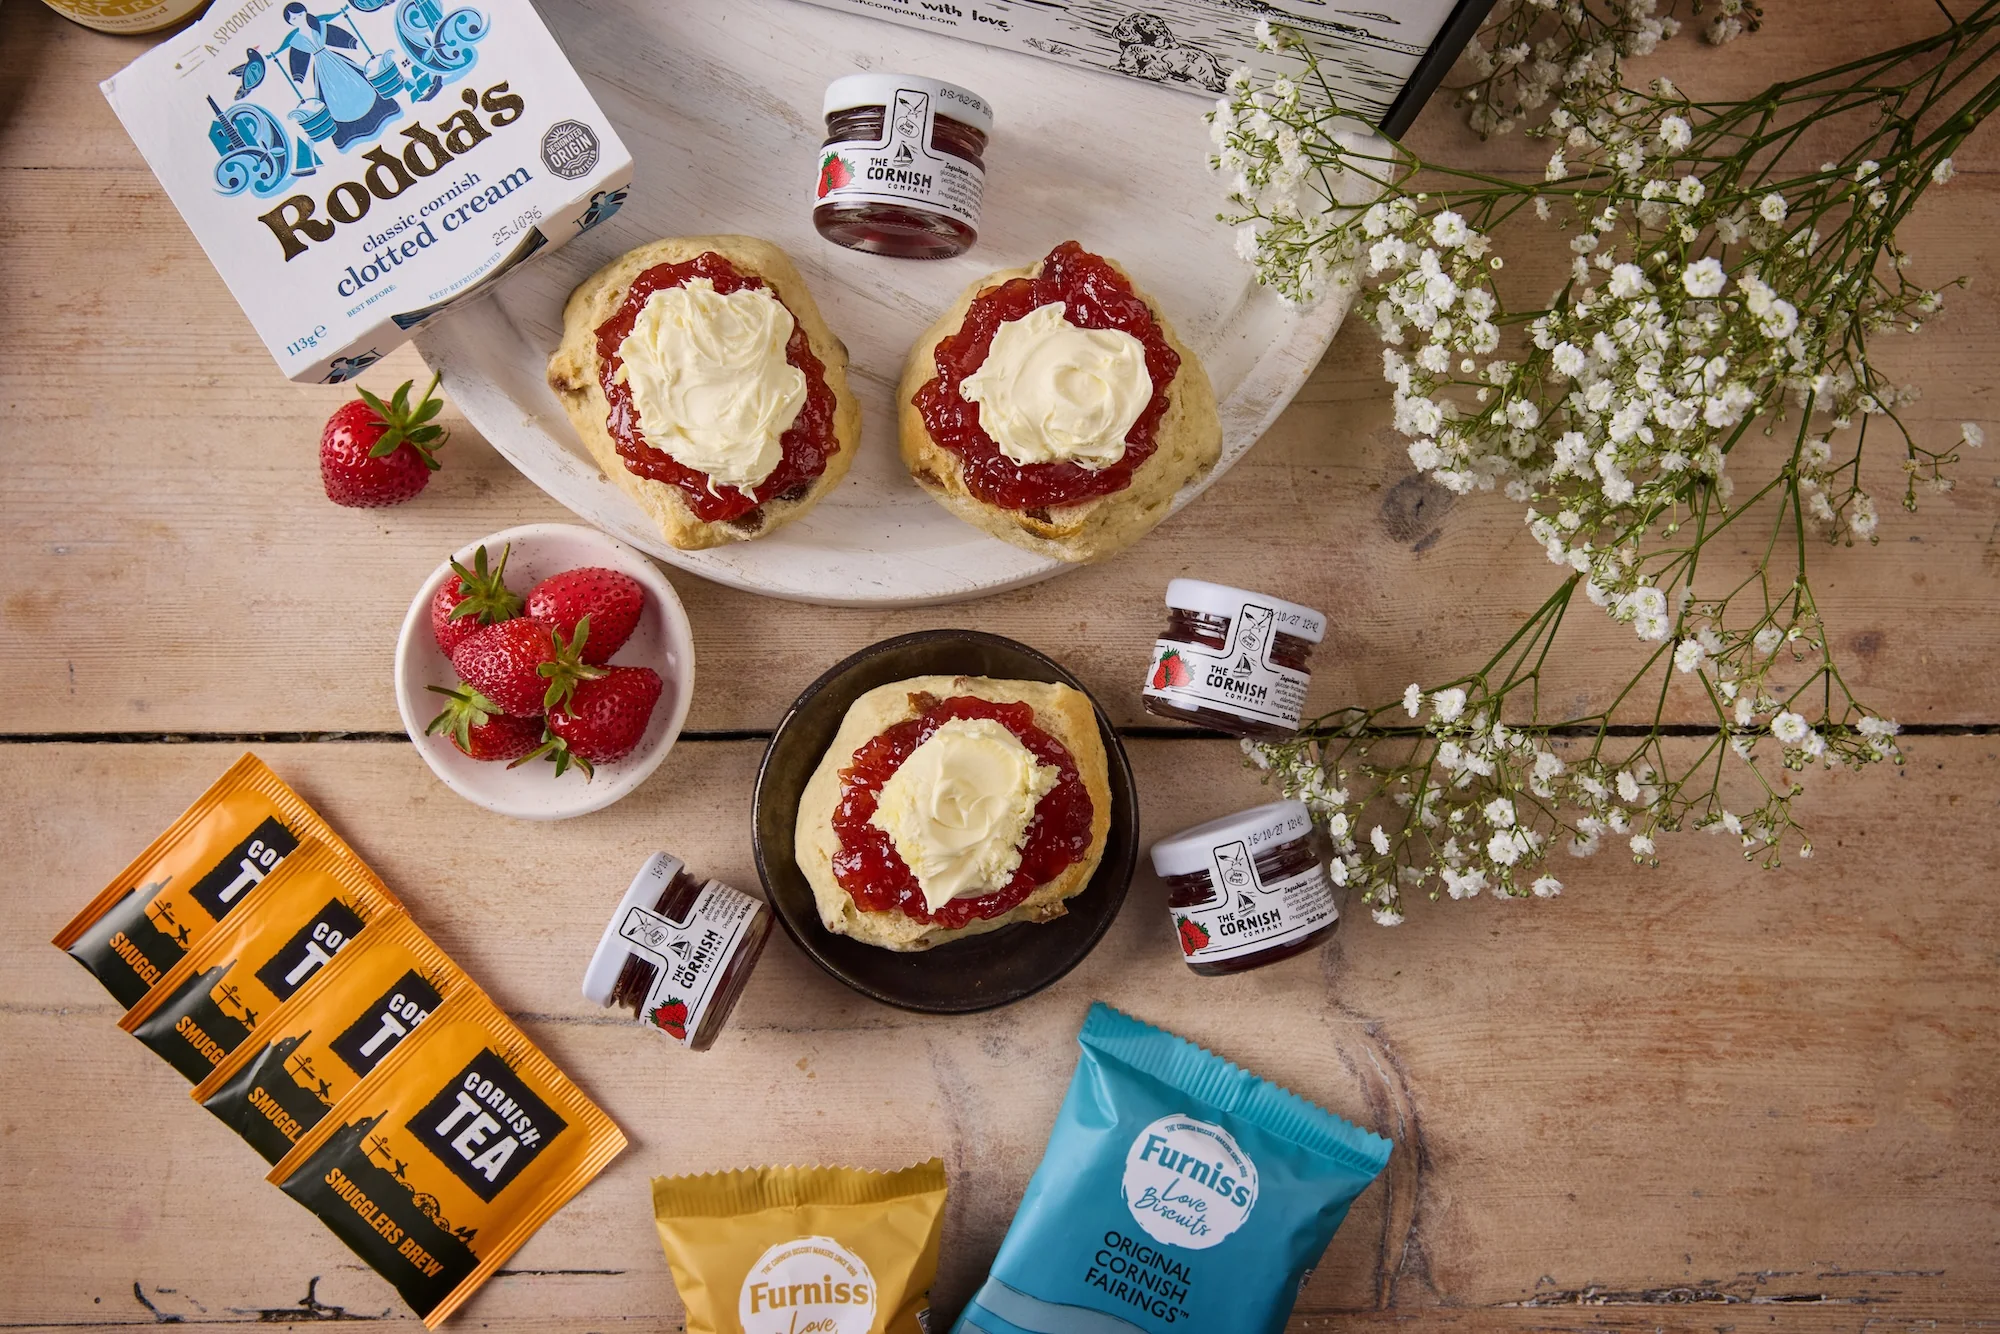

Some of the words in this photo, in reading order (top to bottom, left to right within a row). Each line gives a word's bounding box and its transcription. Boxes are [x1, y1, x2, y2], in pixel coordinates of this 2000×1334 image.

[134, 6, 168, 21] curd
[920, 2, 963, 17] with
[204, 45, 220, 57] A
[547, 127, 583, 155] DESIGNATED
[550, 134, 593, 168] ORIGIN
[257, 80, 525, 262] Rodda's
[572, 150, 596, 175] PROTECTED
[870, 157, 889, 167] THE
[867, 167, 932, 189] CORNISH
[888, 183, 931, 196] COMPANY
[362, 212, 418, 253] classic
[419, 169, 483, 219] cornish
[337, 221, 439, 298] clotted
[442, 164, 534, 233] cream
[428, 287, 449, 301] KEEP
[449, 252, 501, 291] REFRIGERATED
[346, 303, 365, 317] BEST
[1211, 664, 1229, 676] THE
[1206, 674, 1268, 700] CORNISH
[1225, 692, 1265, 706] COMPANY
[1217, 912, 1235, 923] THE
[1220, 908, 1281, 936] CORNISH
[1244, 923, 1283, 939] COMPANY
[681, 929, 719, 989] CORNISH
[702, 936, 724, 974] COMPANY
[672, 964, 686, 982] THE
[175, 1015, 228, 1067] SMUGG
[248, 1086, 306, 1144] SMUGGL
[1165, 1124, 1176, 1133] THE
[435, 1090, 519, 1182] TEA
[1139, 1134, 1251, 1208] Furniss
[1161, 1178, 1207, 1213] Love
[325, 1168, 404, 1245] SMUGGLERS
[397, 1237, 444, 1278] BREW
[1134, 1186, 1212, 1236] Biscuits
[761, 1263, 773, 1275] THE
[1104, 1231, 1192, 1286] ORIGINAL
[1095, 1250, 1188, 1305] CORNISH
[750, 1274, 869, 1315] Furniss
[790, 1310, 836, 1334] Love
